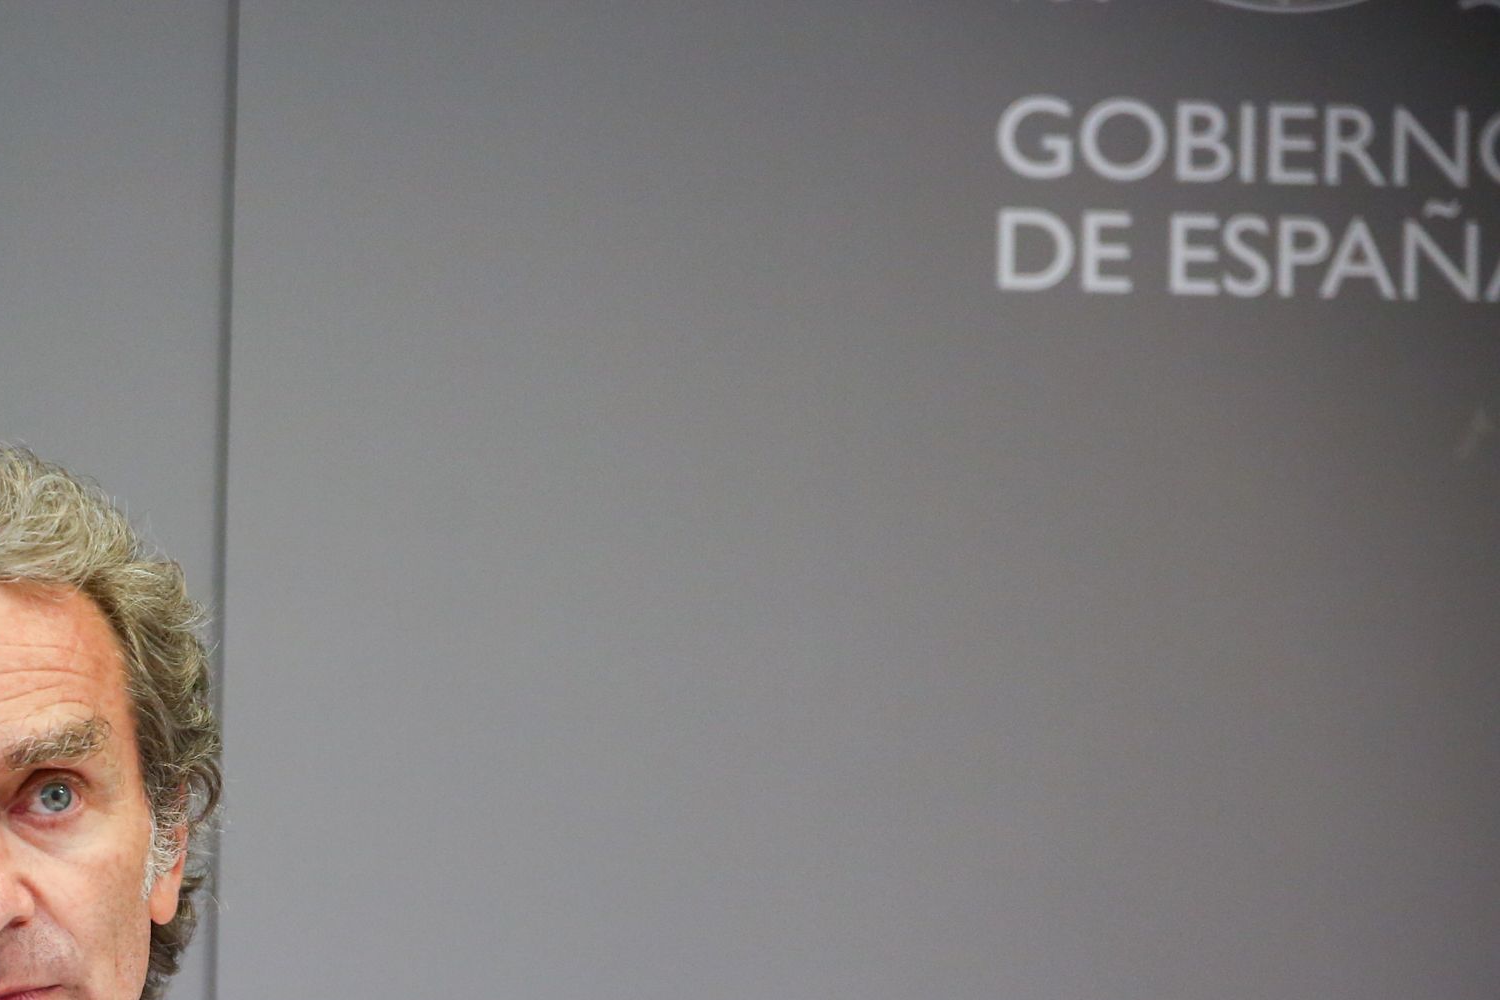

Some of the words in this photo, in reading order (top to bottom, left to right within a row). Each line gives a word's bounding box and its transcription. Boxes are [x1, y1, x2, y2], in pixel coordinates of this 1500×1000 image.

[997, 94, 1500, 188] GOBIERN
[997, 207, 1133, 294] DE
[1169, 199, 1500, 302] ESPAÑ
